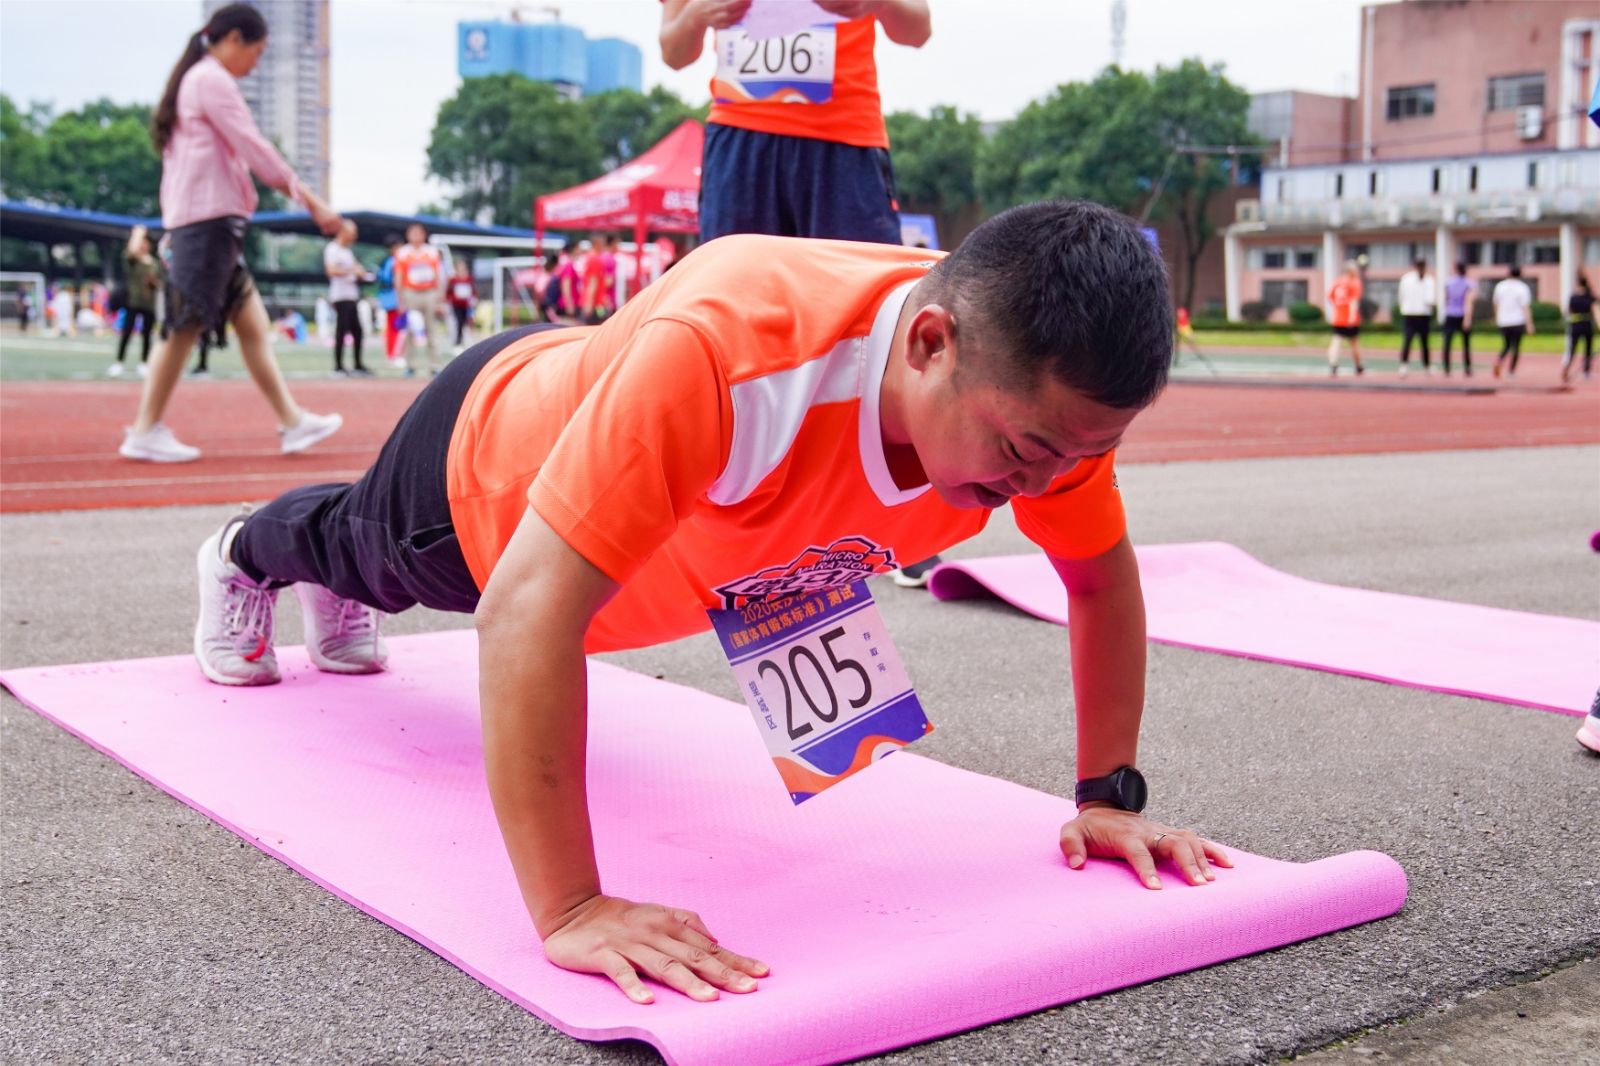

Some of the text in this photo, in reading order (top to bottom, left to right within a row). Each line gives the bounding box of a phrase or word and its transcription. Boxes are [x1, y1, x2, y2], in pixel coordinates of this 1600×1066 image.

[740, 33, 812, 74] 206
[795, 561, 871, 575] MARATHON
[822, 551, 864, 562] MICRO
[758, 626, 872, 741] 205
